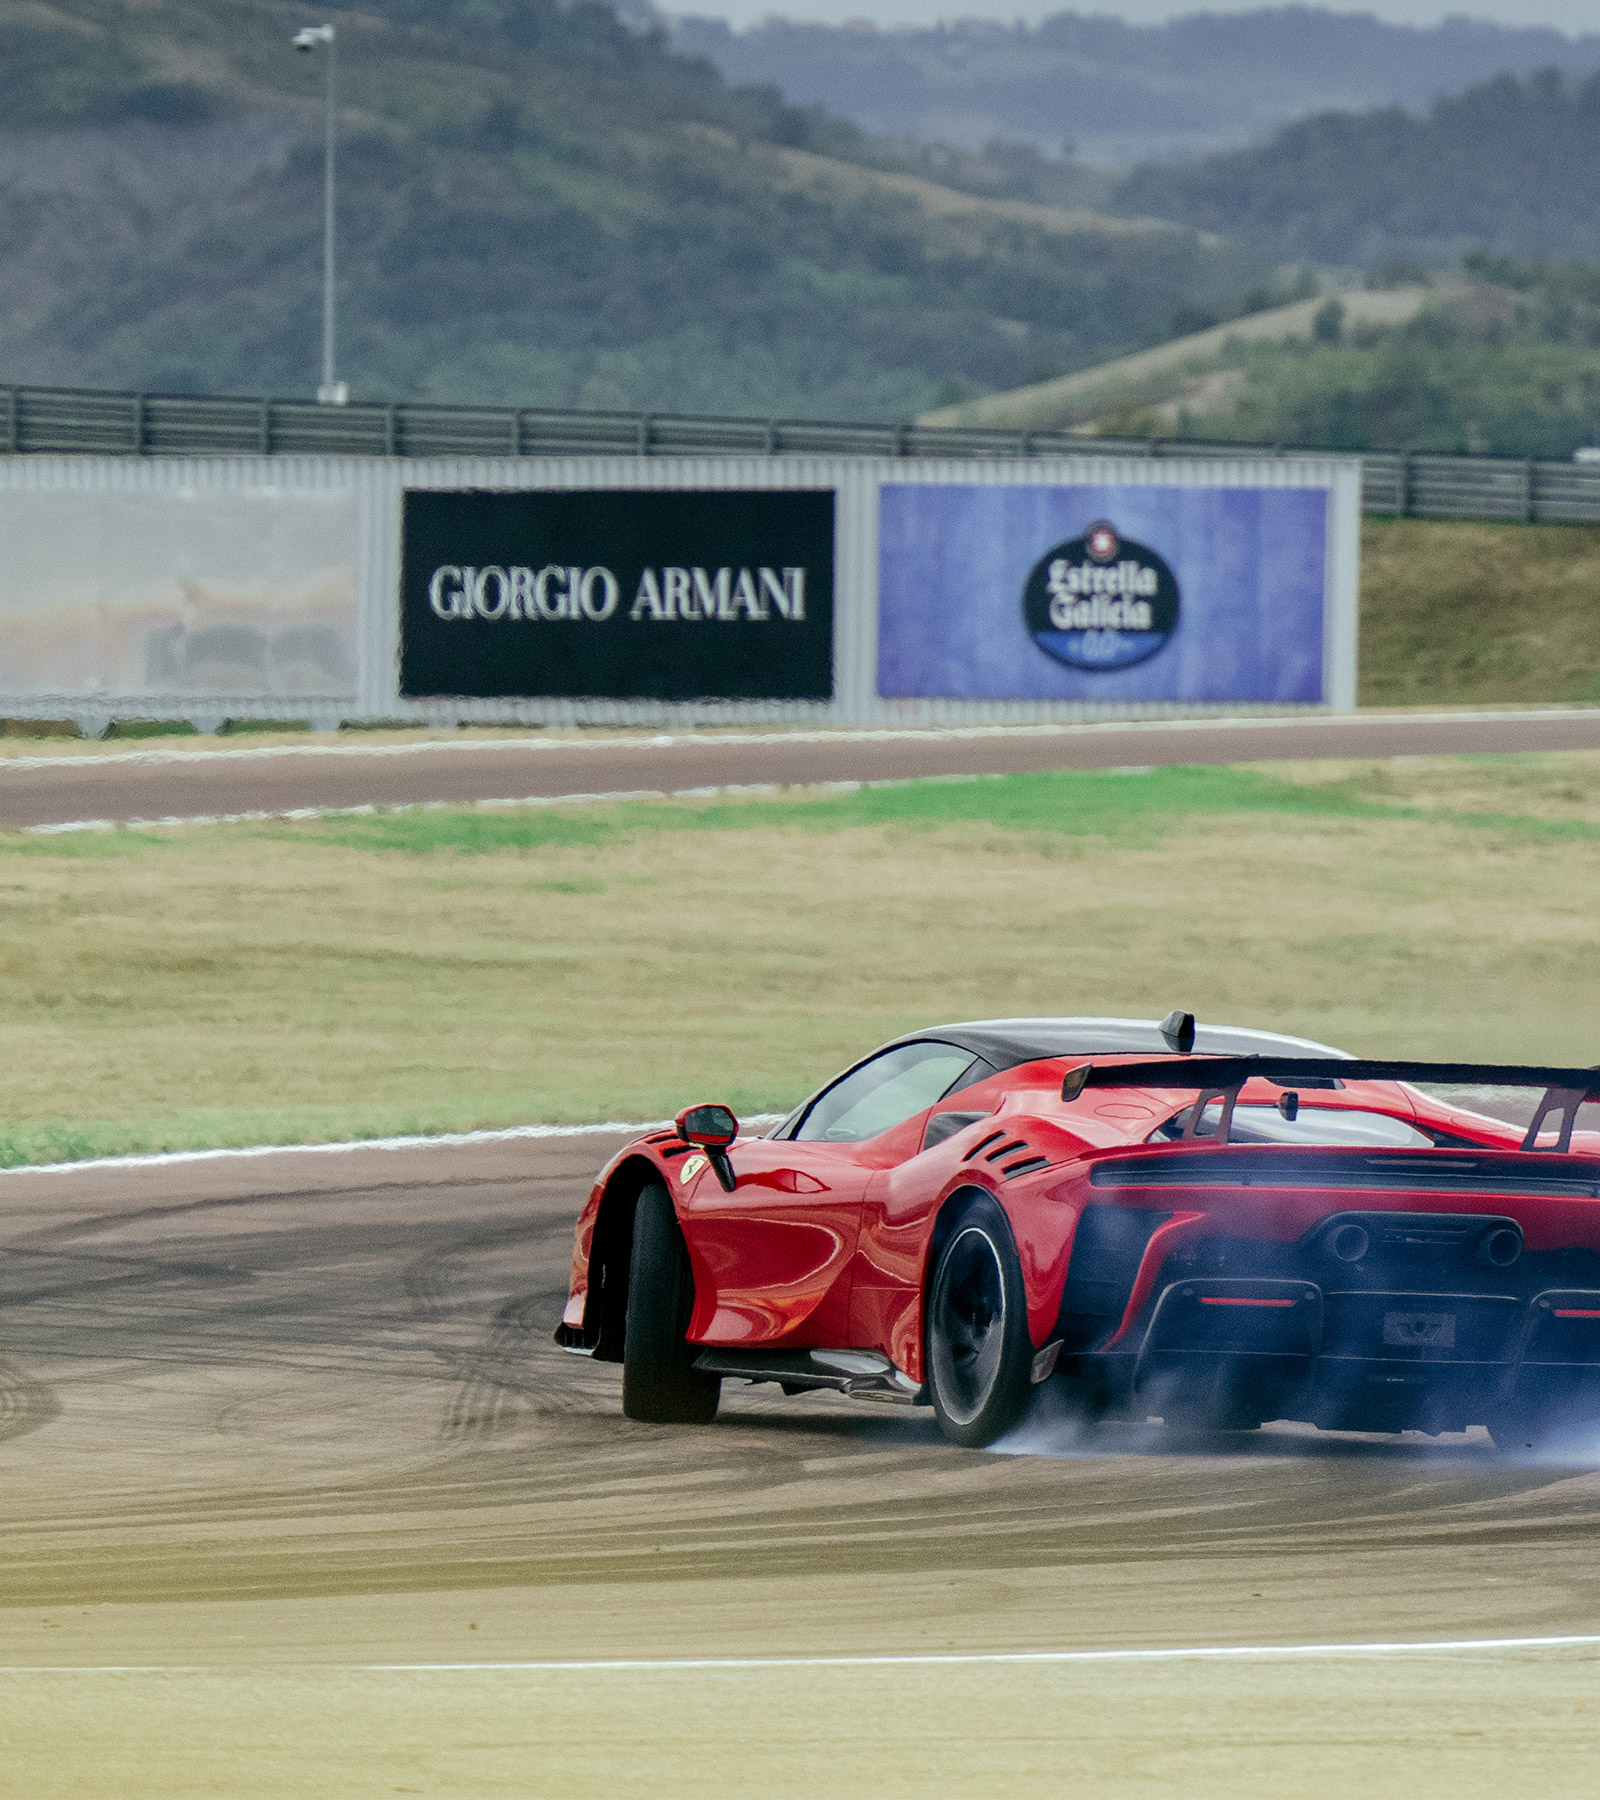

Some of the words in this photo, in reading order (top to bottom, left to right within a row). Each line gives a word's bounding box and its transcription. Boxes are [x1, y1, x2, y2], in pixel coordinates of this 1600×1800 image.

[428, 564, 619, 620] GIORGIO
[629, 565, 805, 620] ARMANI
[1048, 559, 1158, 595] Estrella
[1049, 593, 1152, 630] Galicia
